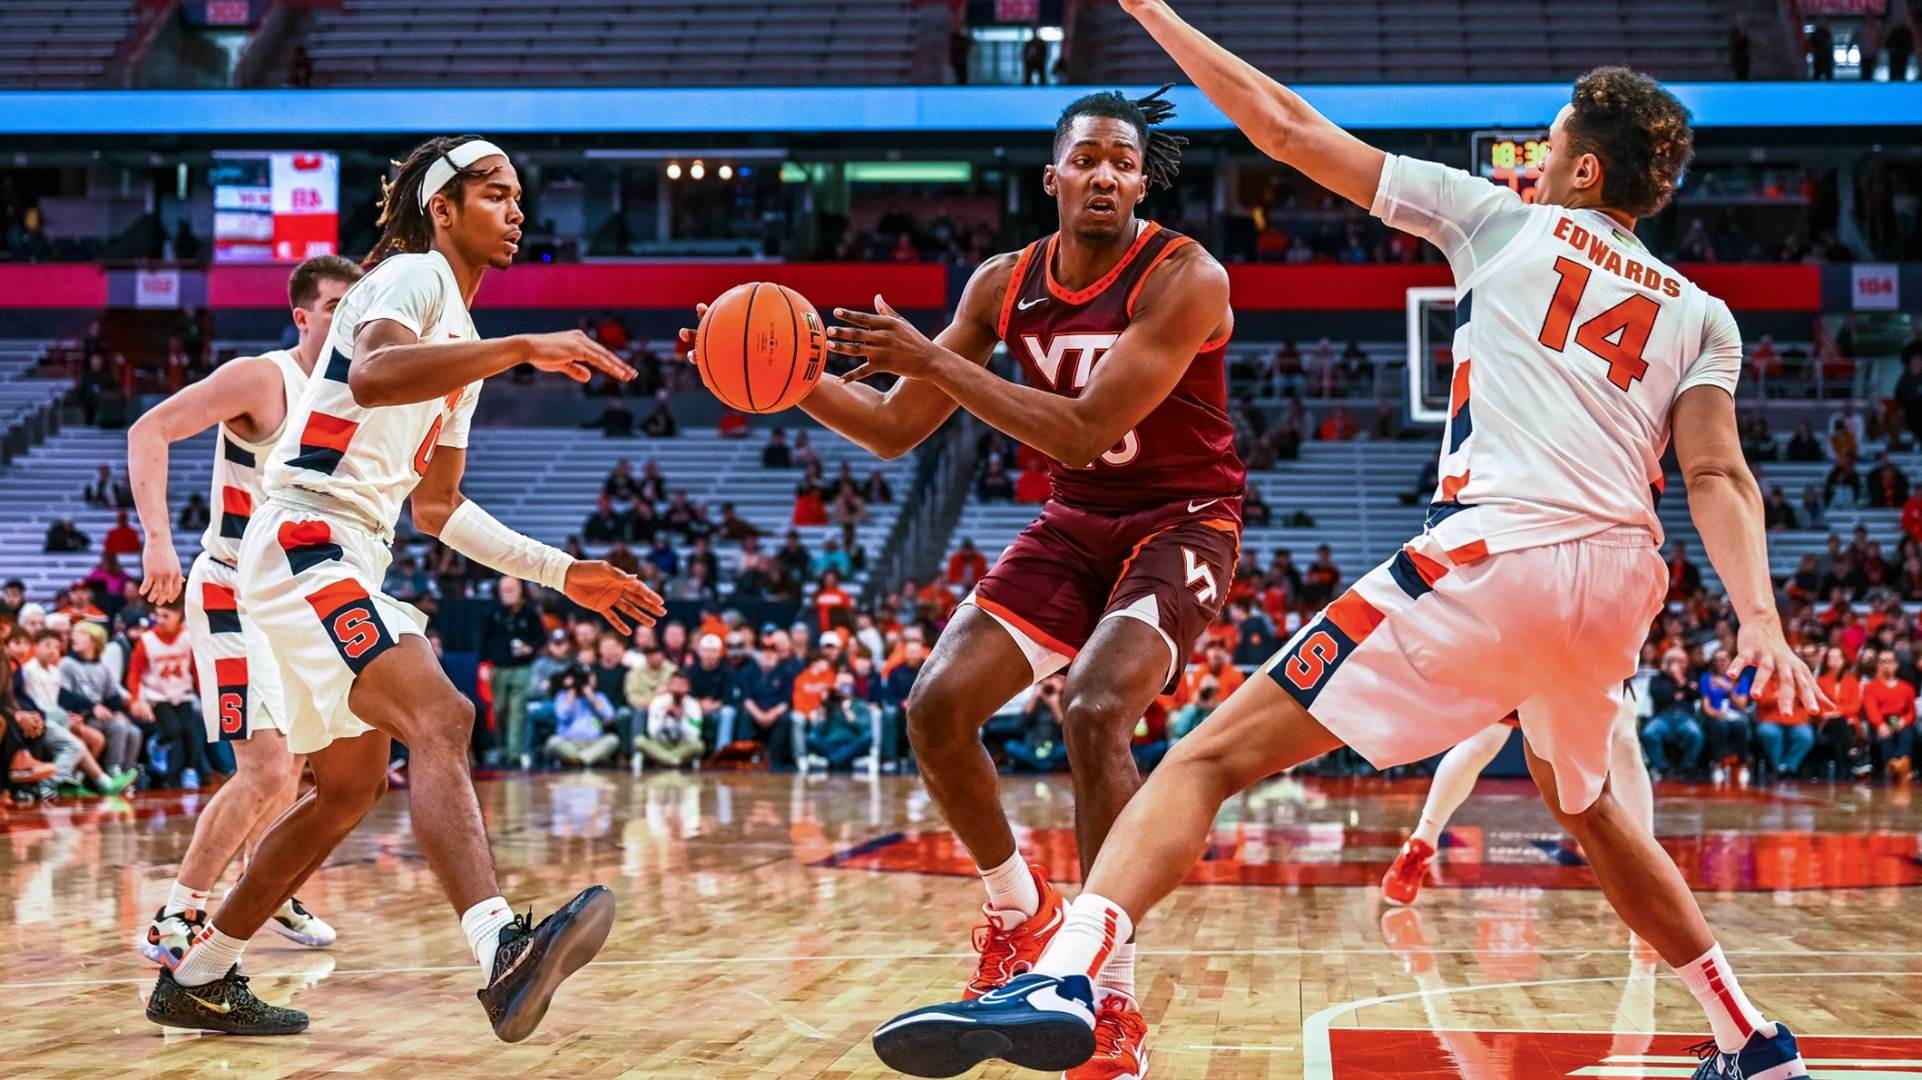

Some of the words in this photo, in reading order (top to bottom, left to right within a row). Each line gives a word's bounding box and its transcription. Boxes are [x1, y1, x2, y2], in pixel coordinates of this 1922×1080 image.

[1553, 216, 1681, 298] EDWARDS
[802, 312, 821, 381] ELITE
[1538, 255, 1661, 393] 14
[1020, 331, 1125, 391] VT
[1181, 546, 1218, 606] VT
[333, 607, 380, 659] S
[1285, 630, 1338, 690] S
[220, 693, 243, 733] S
